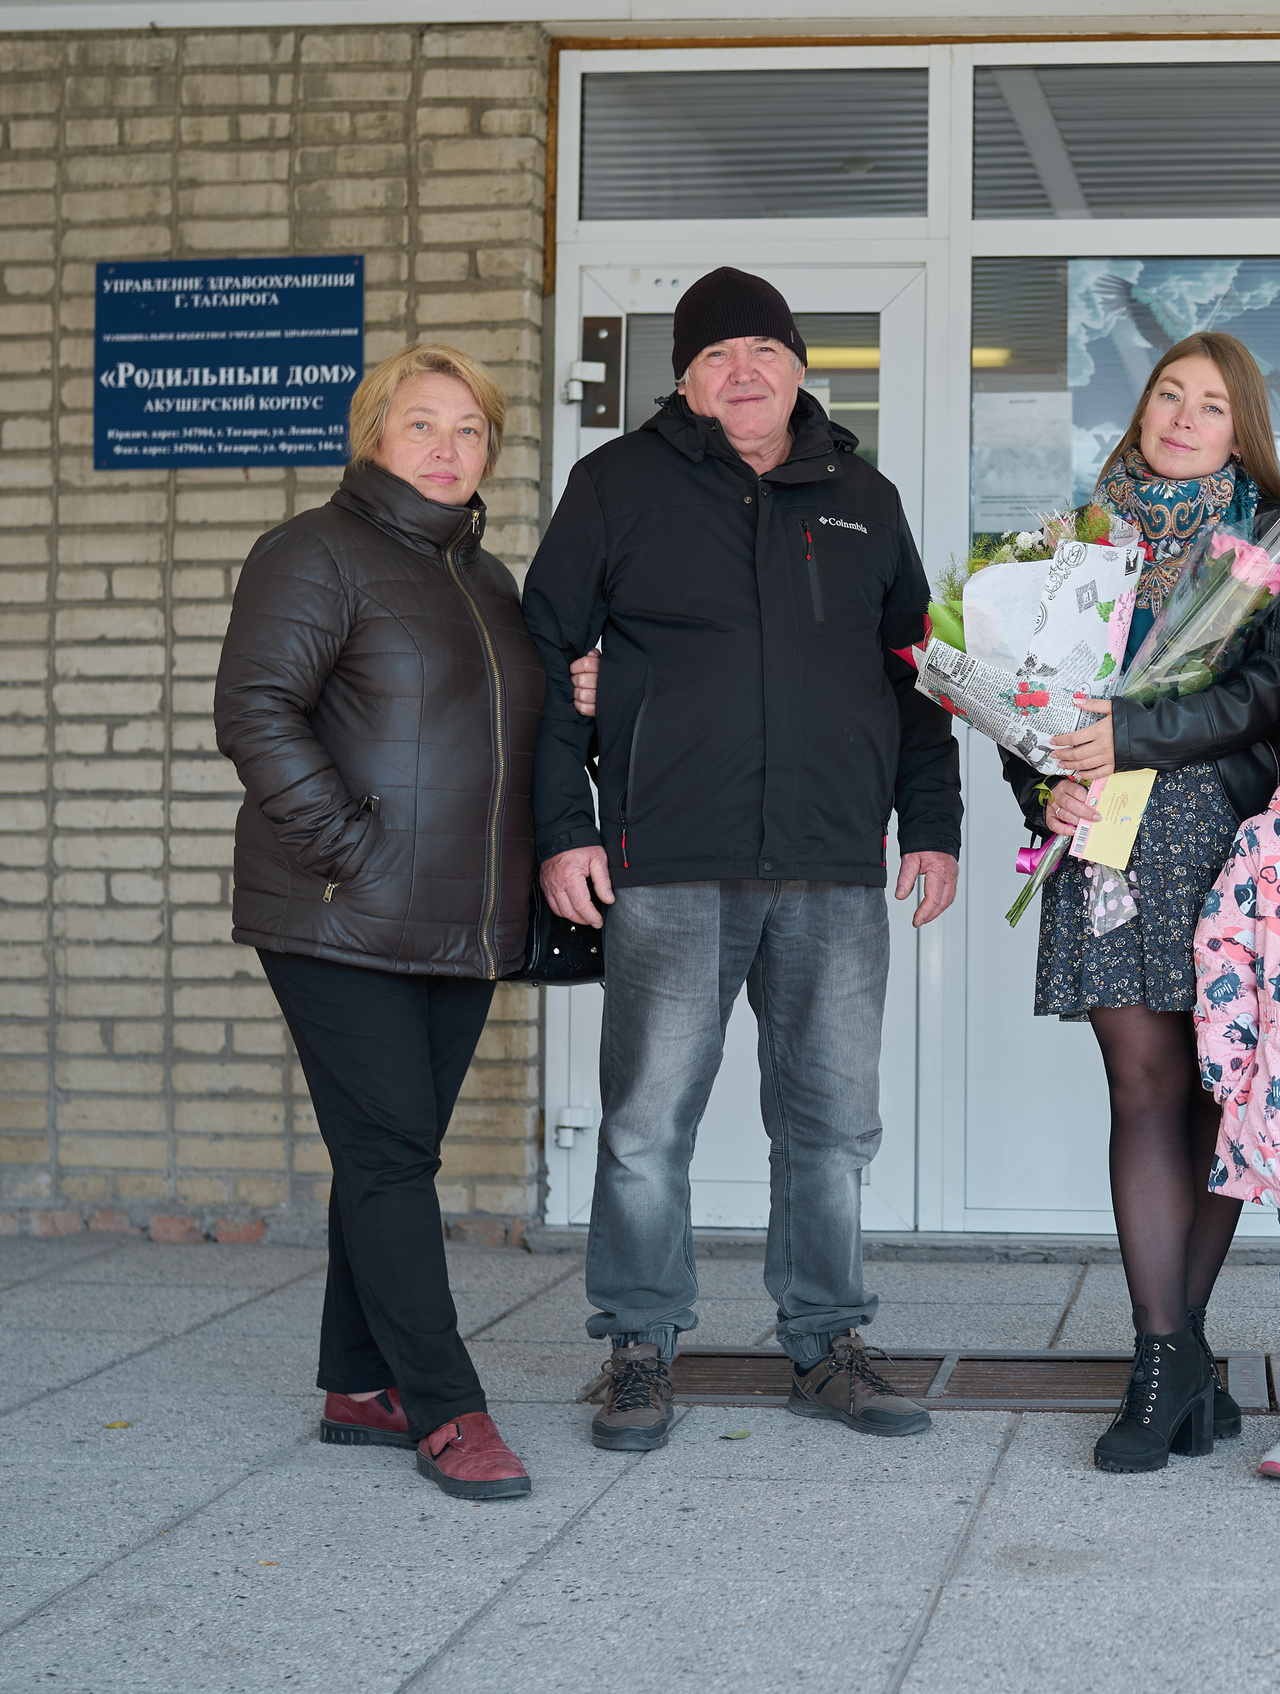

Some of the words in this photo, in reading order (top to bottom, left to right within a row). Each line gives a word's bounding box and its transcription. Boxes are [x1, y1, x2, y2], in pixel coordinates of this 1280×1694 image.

[103, 276, 204, 294] УПРАВЛЕНИЕ
[206, 272, 356, 292] ЗДРАВООХРАНЕНИЯ
[174, 293, 189, 309] Г.
[190, 291, 280, 308] ТАГАНРОГА
[285, 364, 357, 388] дом»
[143, 394, 257, 414] АКУШЕРСКИЙ
[258, 395, 324, 412] КОРПУС
[828, 517, 869, 535] Columbia
